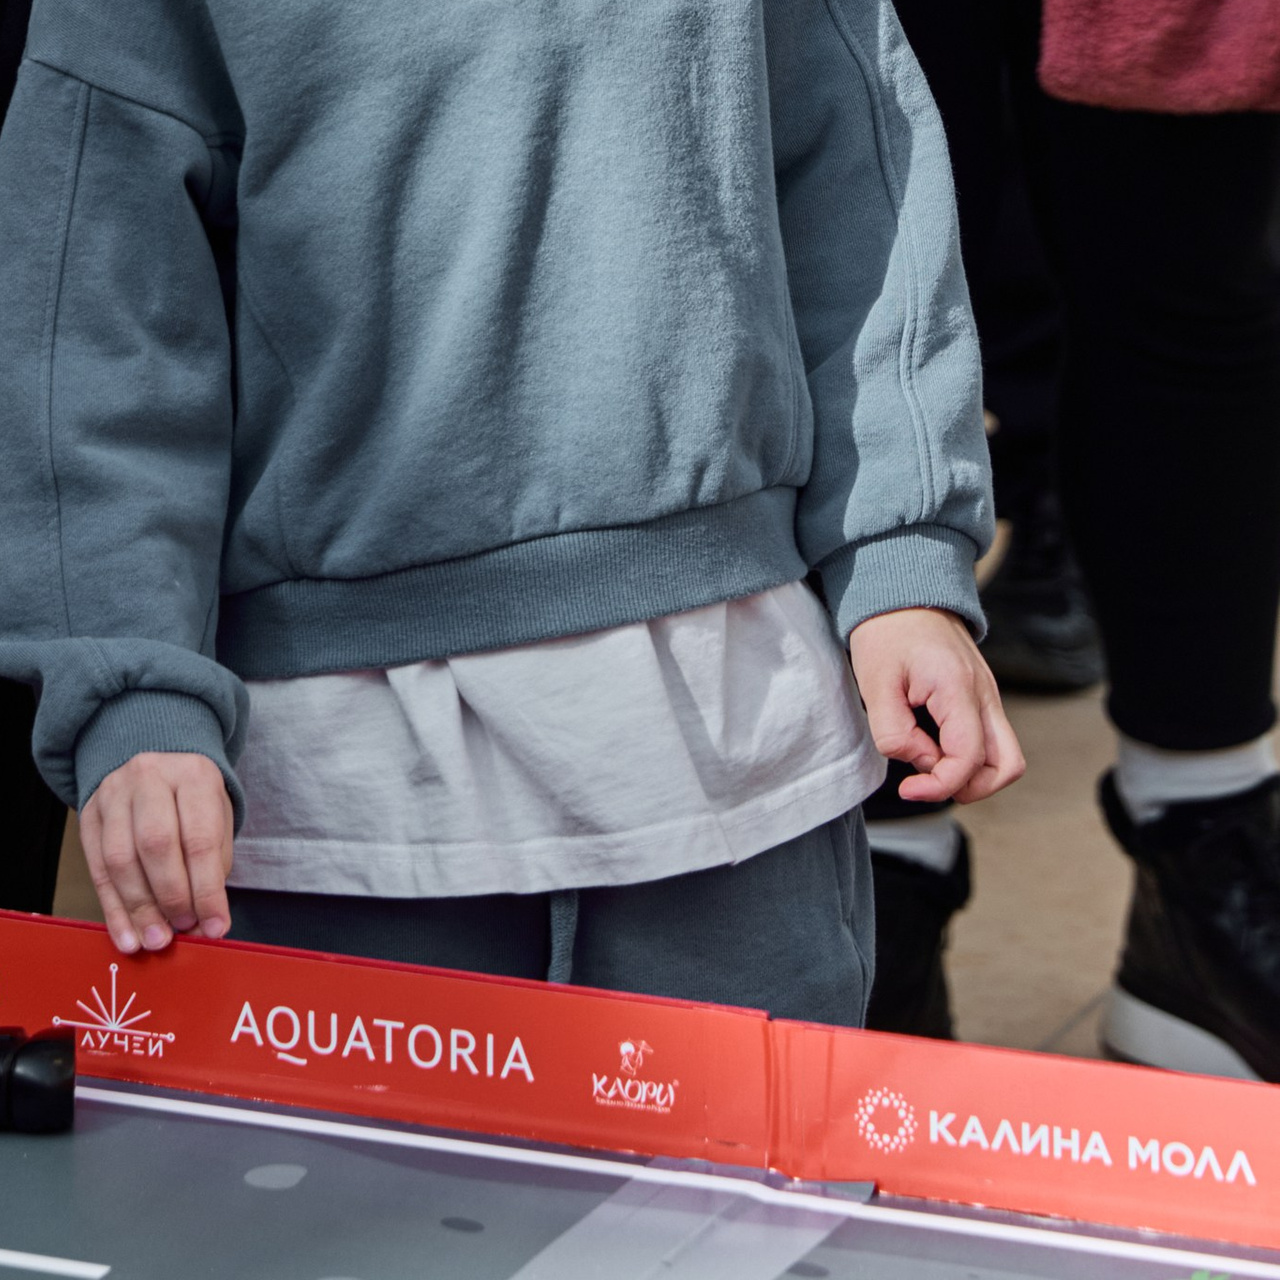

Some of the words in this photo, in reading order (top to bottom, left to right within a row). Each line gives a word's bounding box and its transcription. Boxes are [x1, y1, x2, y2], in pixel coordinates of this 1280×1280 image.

[231, 1001, 535, 1083] AQUATORIA
[929, 1110, 1113, 1167] КАЛИНА
[1128, 1136, 1257, 1187] МОЛЛ
